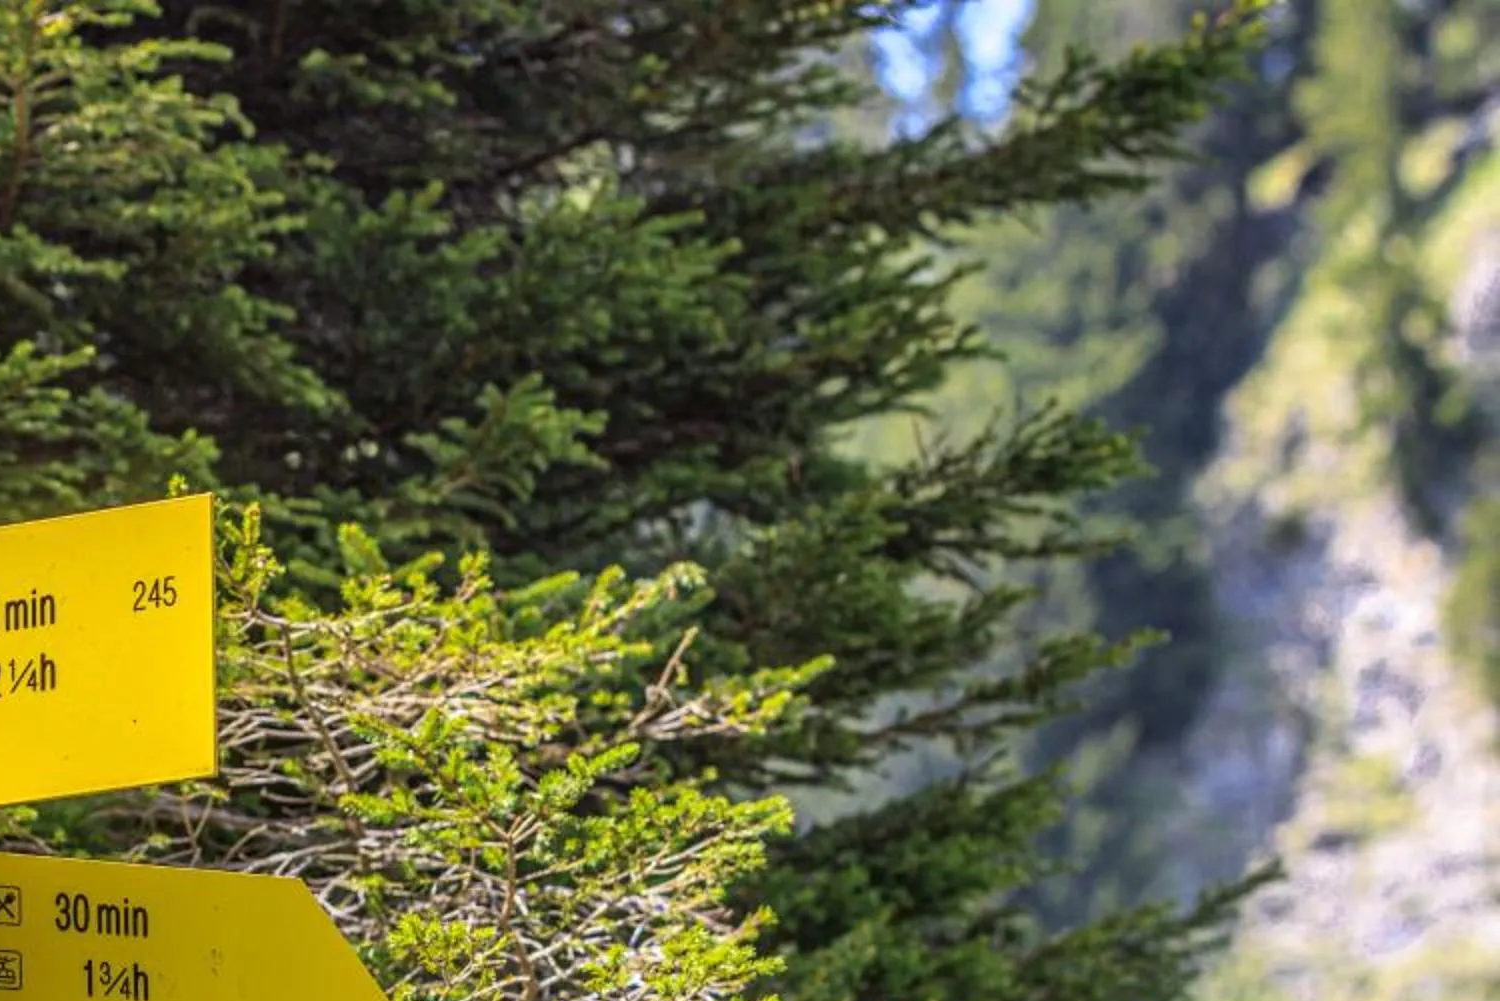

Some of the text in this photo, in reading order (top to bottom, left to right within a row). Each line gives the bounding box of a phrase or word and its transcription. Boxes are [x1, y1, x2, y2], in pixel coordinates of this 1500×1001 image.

[4, 588, 56, 632] min
[132, 575, 178, 613] 245
[54, 891, 149, 938] 30 min
